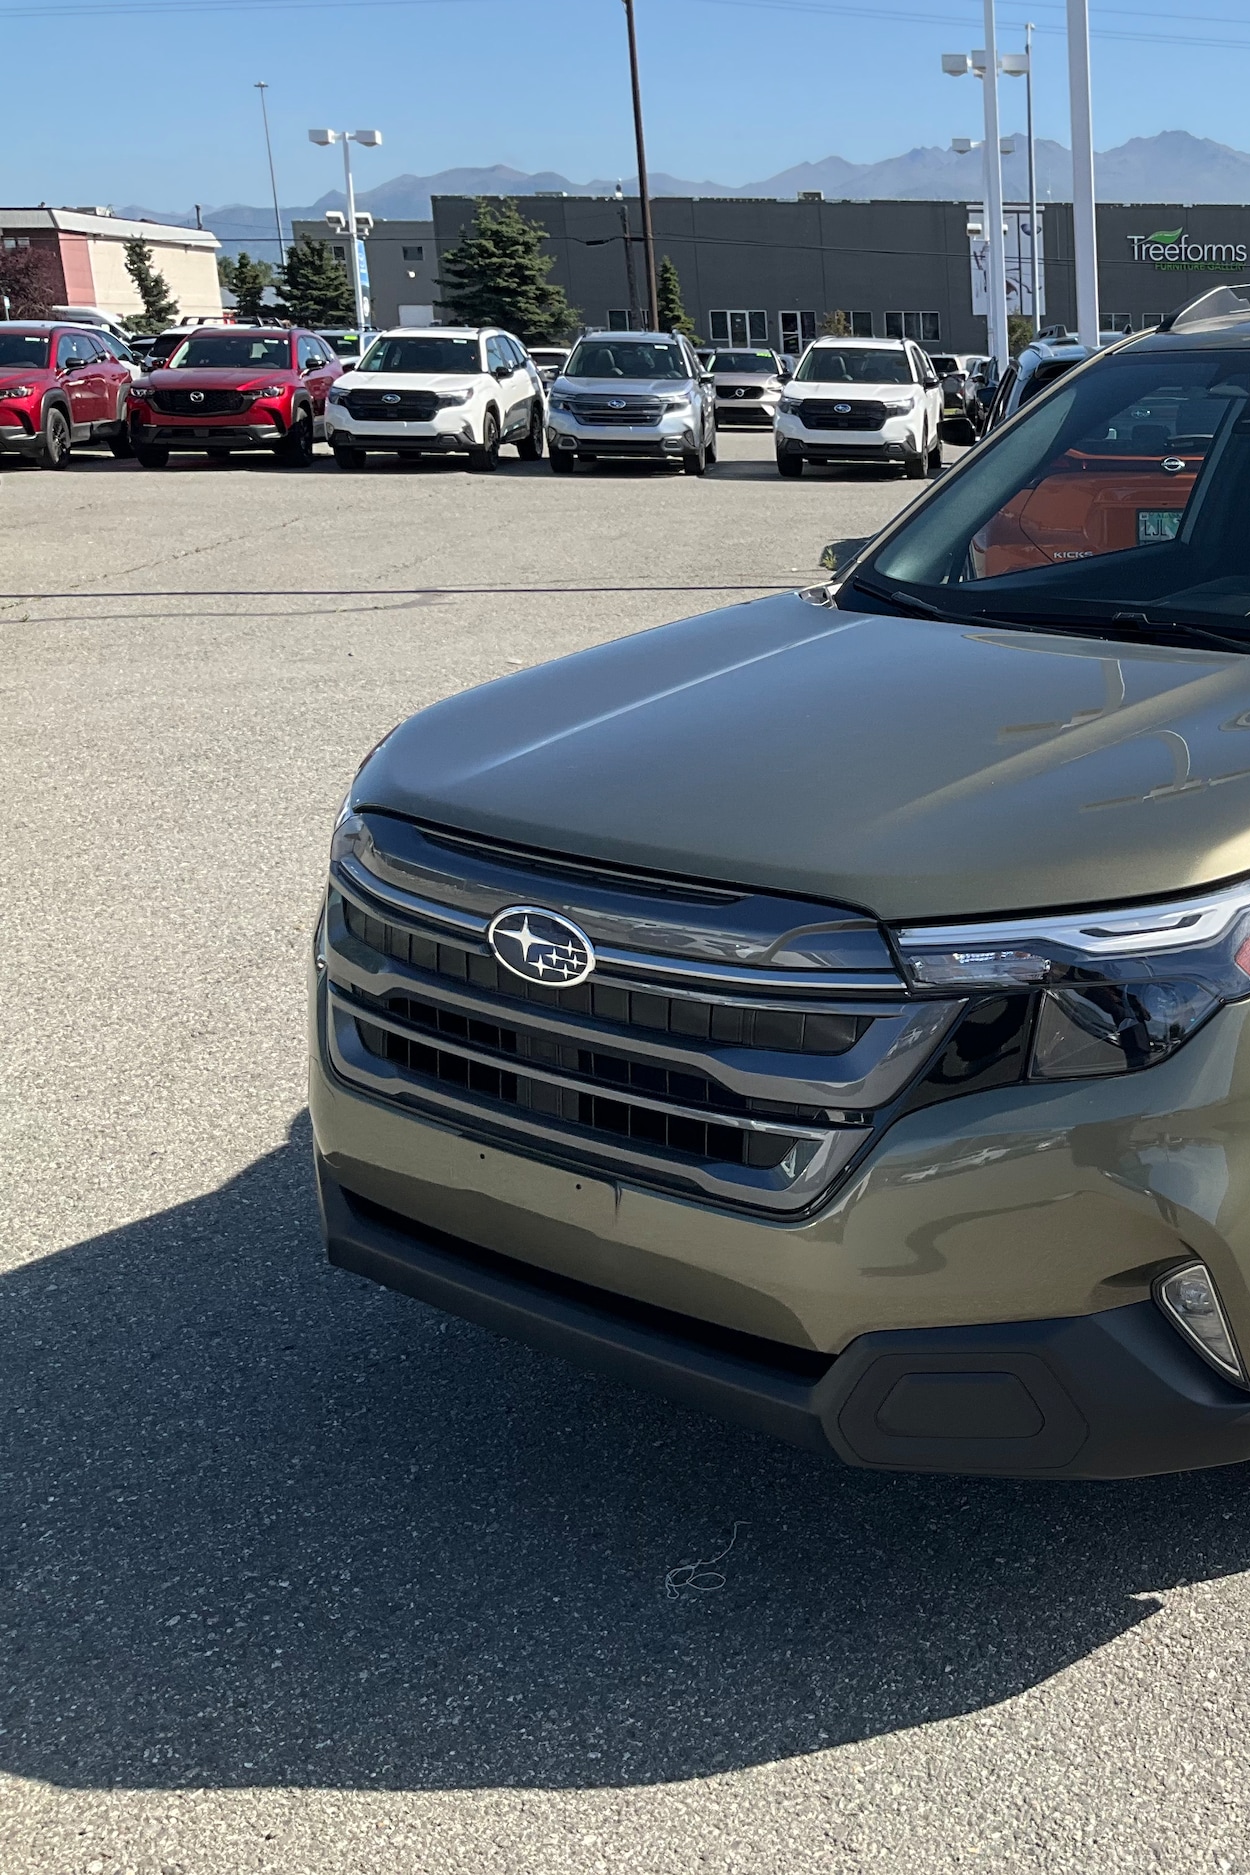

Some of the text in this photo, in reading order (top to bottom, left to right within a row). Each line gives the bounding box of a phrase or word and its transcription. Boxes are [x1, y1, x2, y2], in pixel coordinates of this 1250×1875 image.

[1127, 234, 1247, 262] Treeforms
[1155, 262, 1246, 272] FURNITURE GALLERY
[1144, 519, 1168, 536] LJL
[1053, 551, 1094, 559] KICKS
